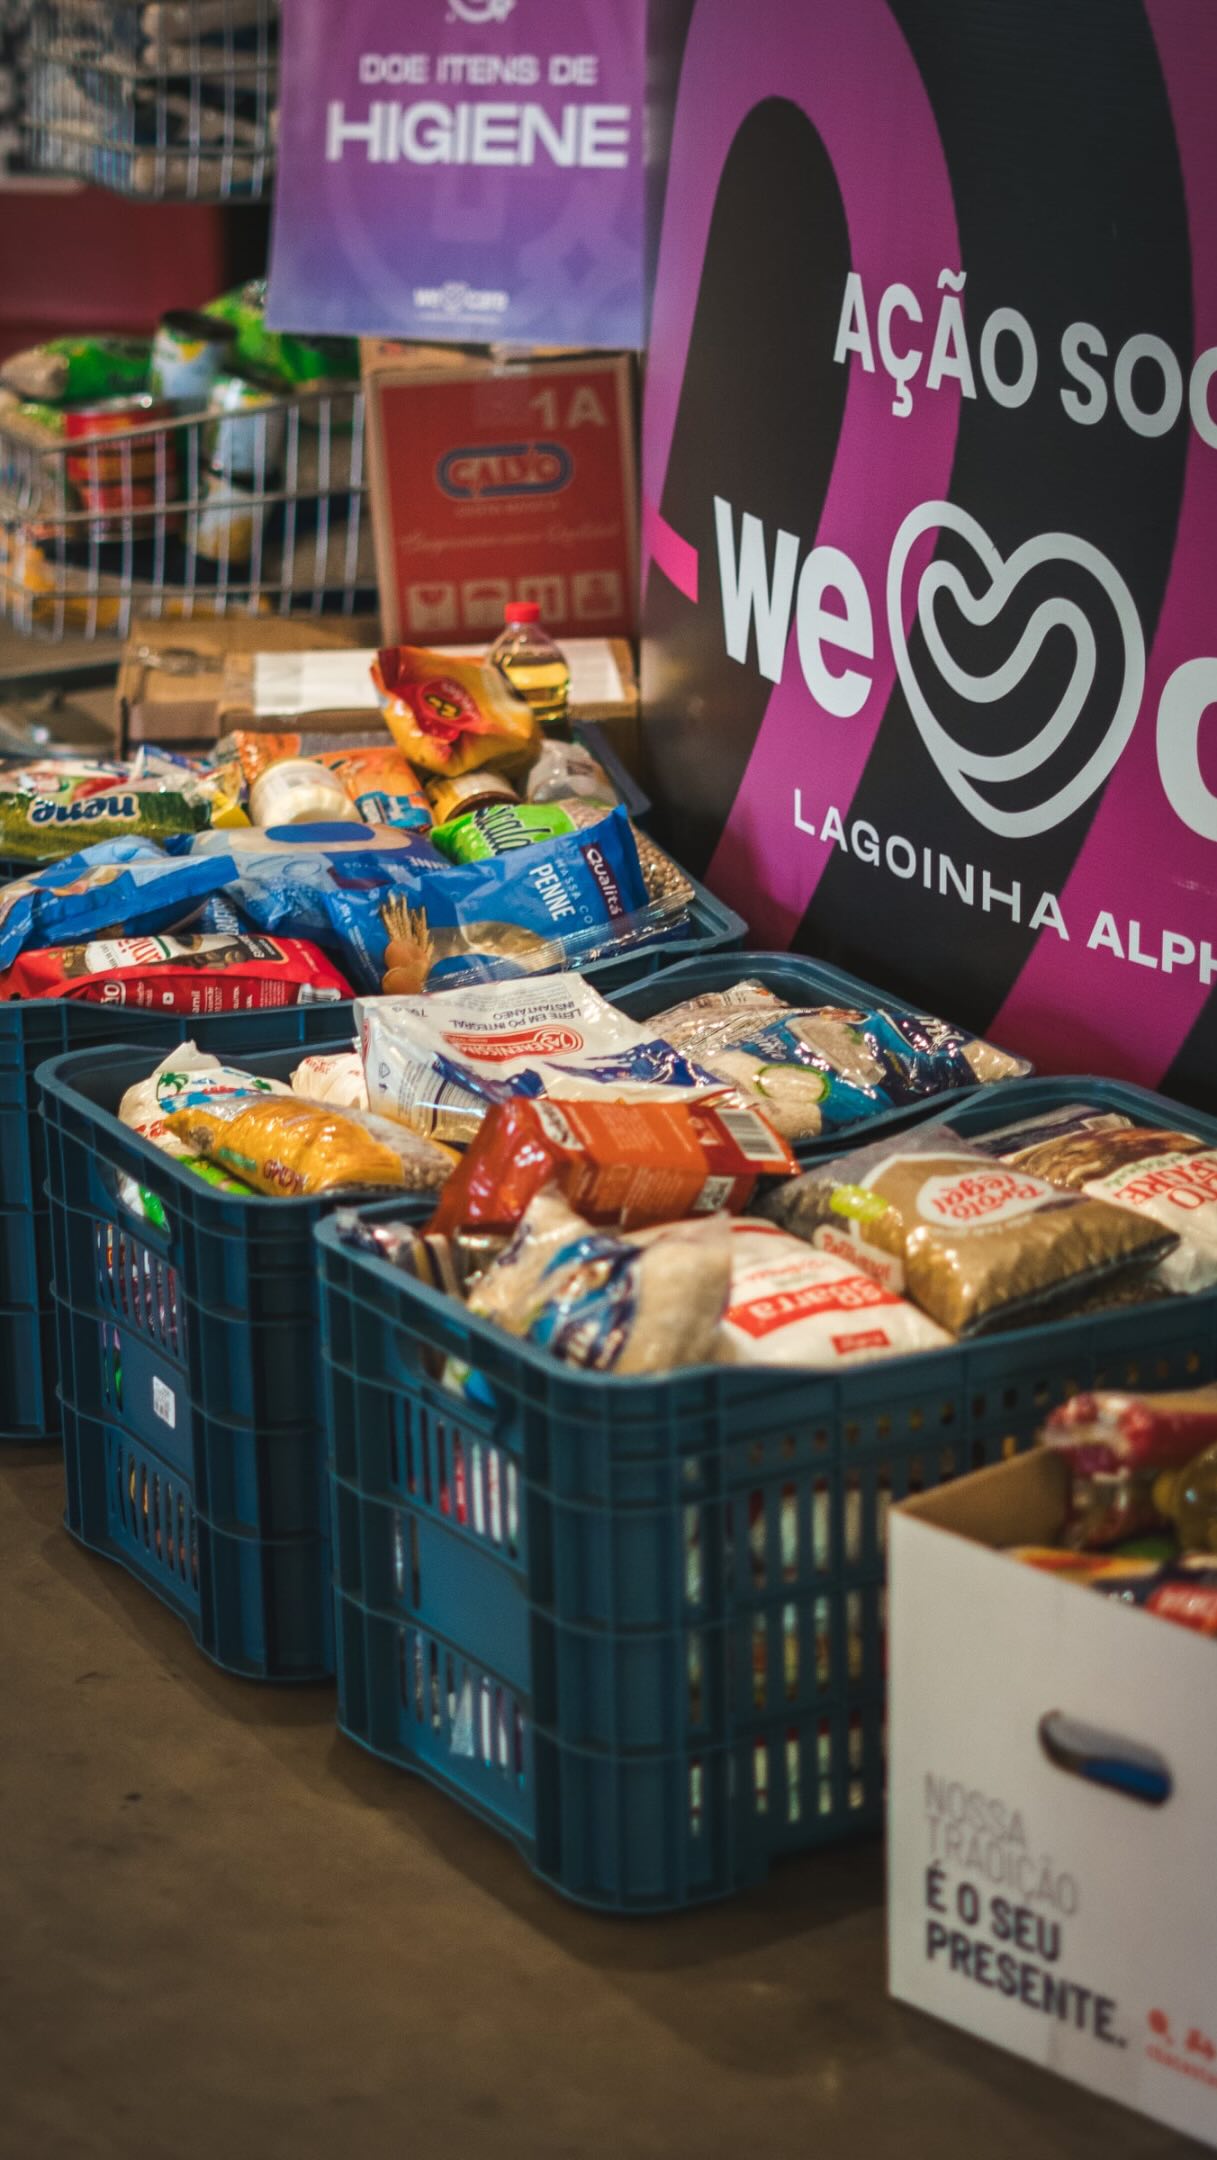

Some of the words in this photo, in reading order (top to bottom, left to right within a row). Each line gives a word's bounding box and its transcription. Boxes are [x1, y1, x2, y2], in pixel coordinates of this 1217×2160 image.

[359, 55, 430, 85] DOE
[436, 55, 539, 85] ITENS
[548, 55, 598, 85] DE
[325, 101, 631, 169] HIGIENE
[833, 268, 1038, 418] AÇÃO
[713, 494, 875, 718] we
[528, 862, 577, 922] PENNE
[793, 787, 1070, 941] LAGOINHA
[448, 1018, 507, 1032] INTEGRAL
[924, 1770, 1026, 1847] NOSSA
[924, 1858, 947, 1914] É
[956, 1881, 981, 1927] O
[989, 1896, 1061, 1964] SEU
[925, 1920, 1128, 2049] PRESENTE.
